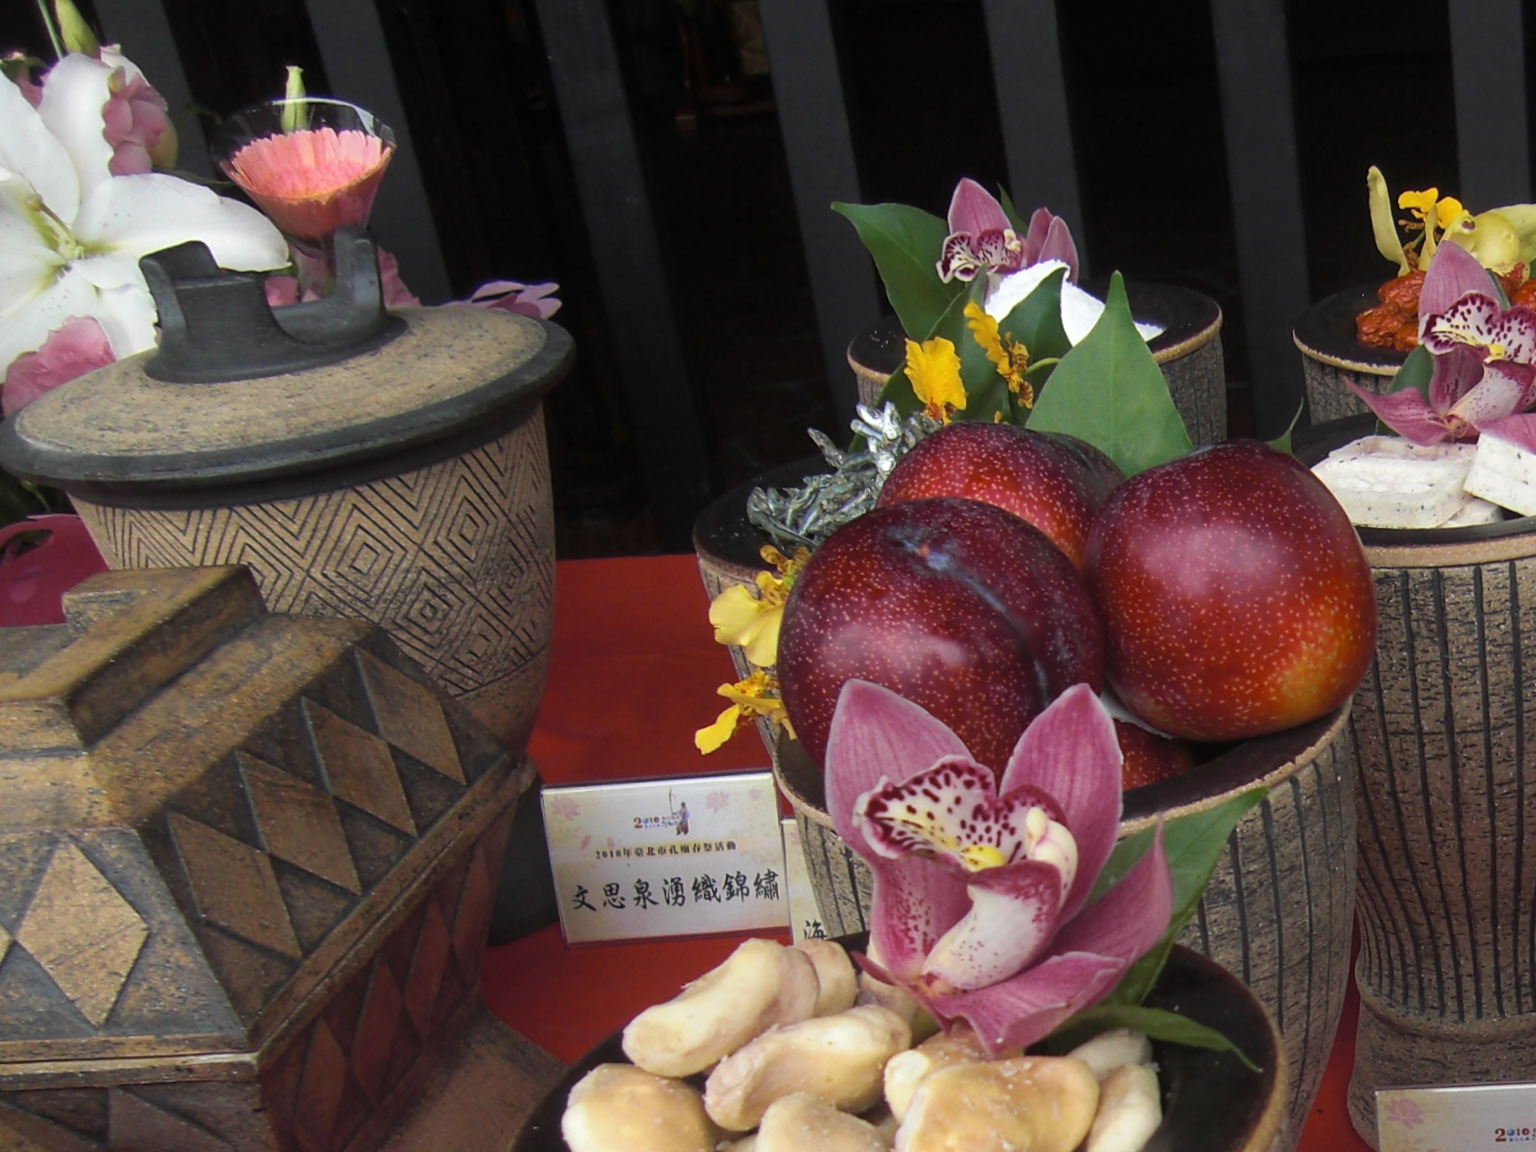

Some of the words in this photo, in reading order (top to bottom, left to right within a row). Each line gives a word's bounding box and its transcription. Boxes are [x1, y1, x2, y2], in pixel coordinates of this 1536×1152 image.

[572, 869, 780, 912] 文思泉湧織錦繡
